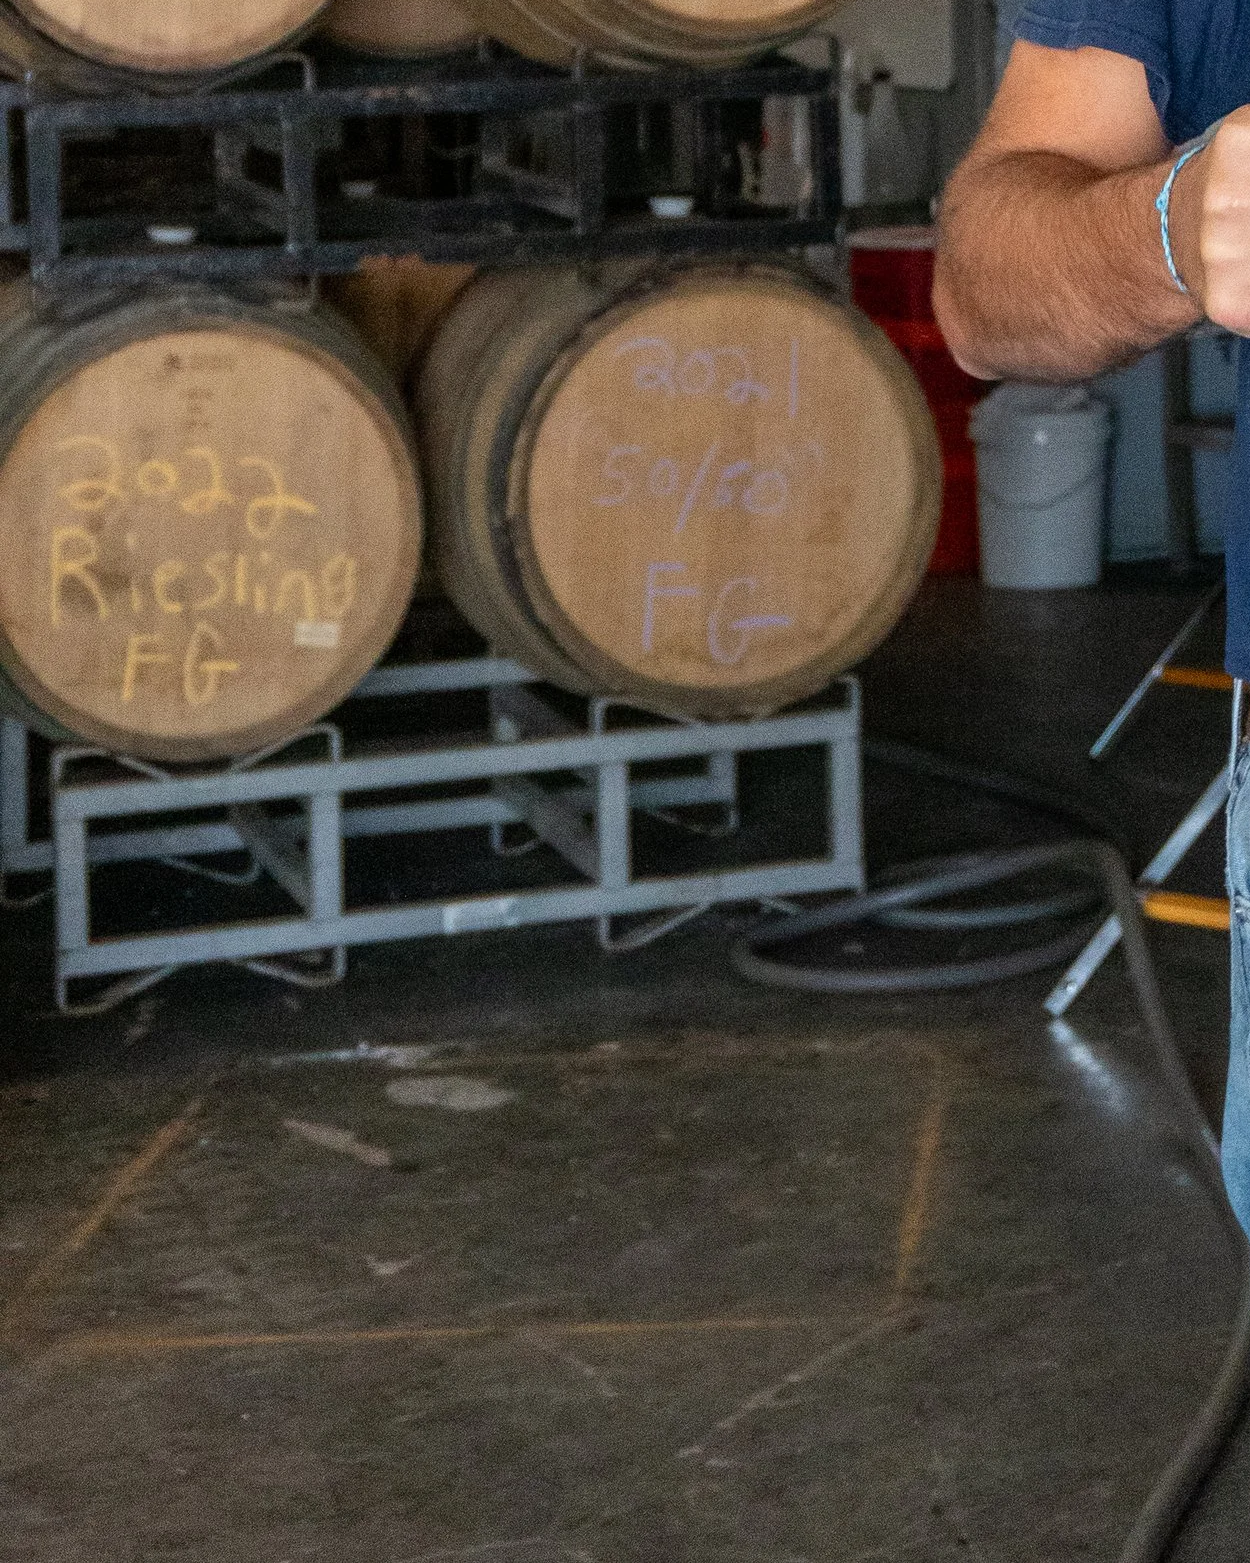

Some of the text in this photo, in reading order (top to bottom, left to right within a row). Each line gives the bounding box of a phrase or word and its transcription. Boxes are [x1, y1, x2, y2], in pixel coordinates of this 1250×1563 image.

[615, 335, 798, 419] 2021
[54, 435, 321, 540] 2022
[52, 524, 359, 628] Riesling
[640, 560, 793, 666] FG
[120, 620, 241, 706] FG
